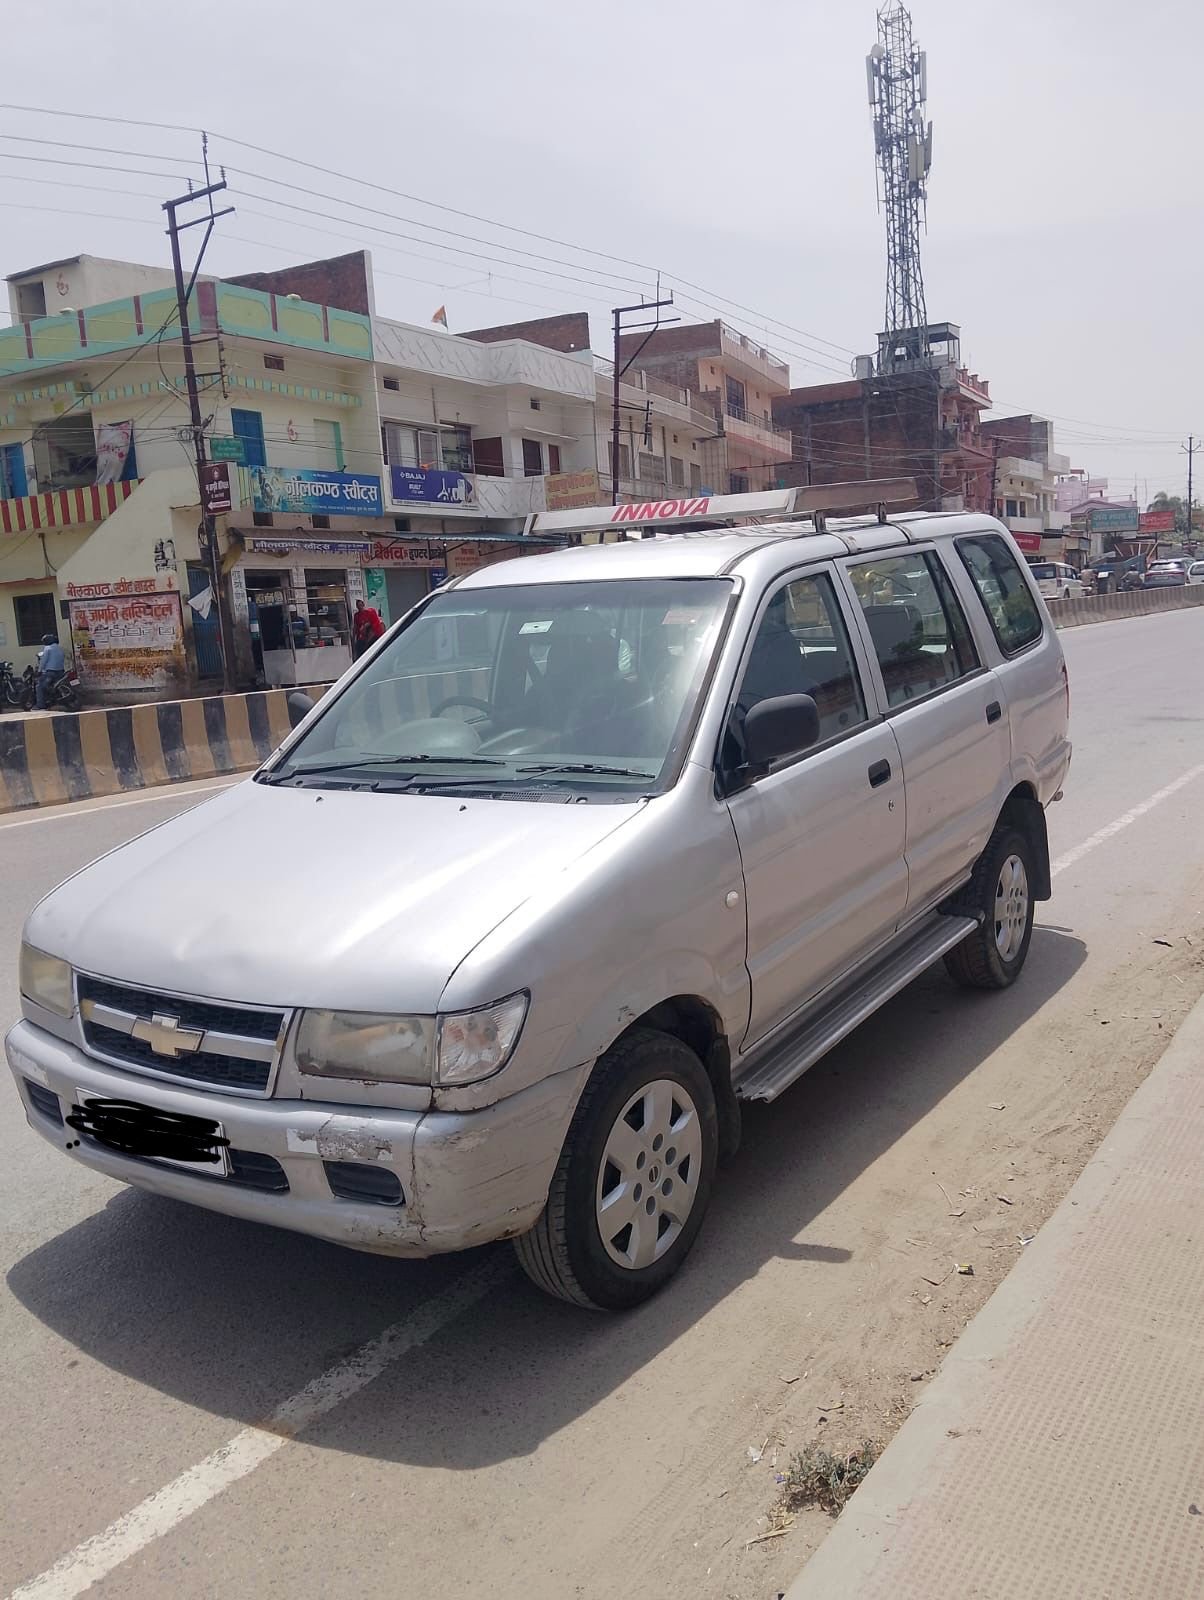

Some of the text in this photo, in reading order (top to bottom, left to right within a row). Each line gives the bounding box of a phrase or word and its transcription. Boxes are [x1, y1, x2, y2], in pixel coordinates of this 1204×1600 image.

[405, 472, 426, 480] BAJAJ
[342, 480, 378, 503] स्वीट्स
[611, 498, 709, 522] INNOVA
